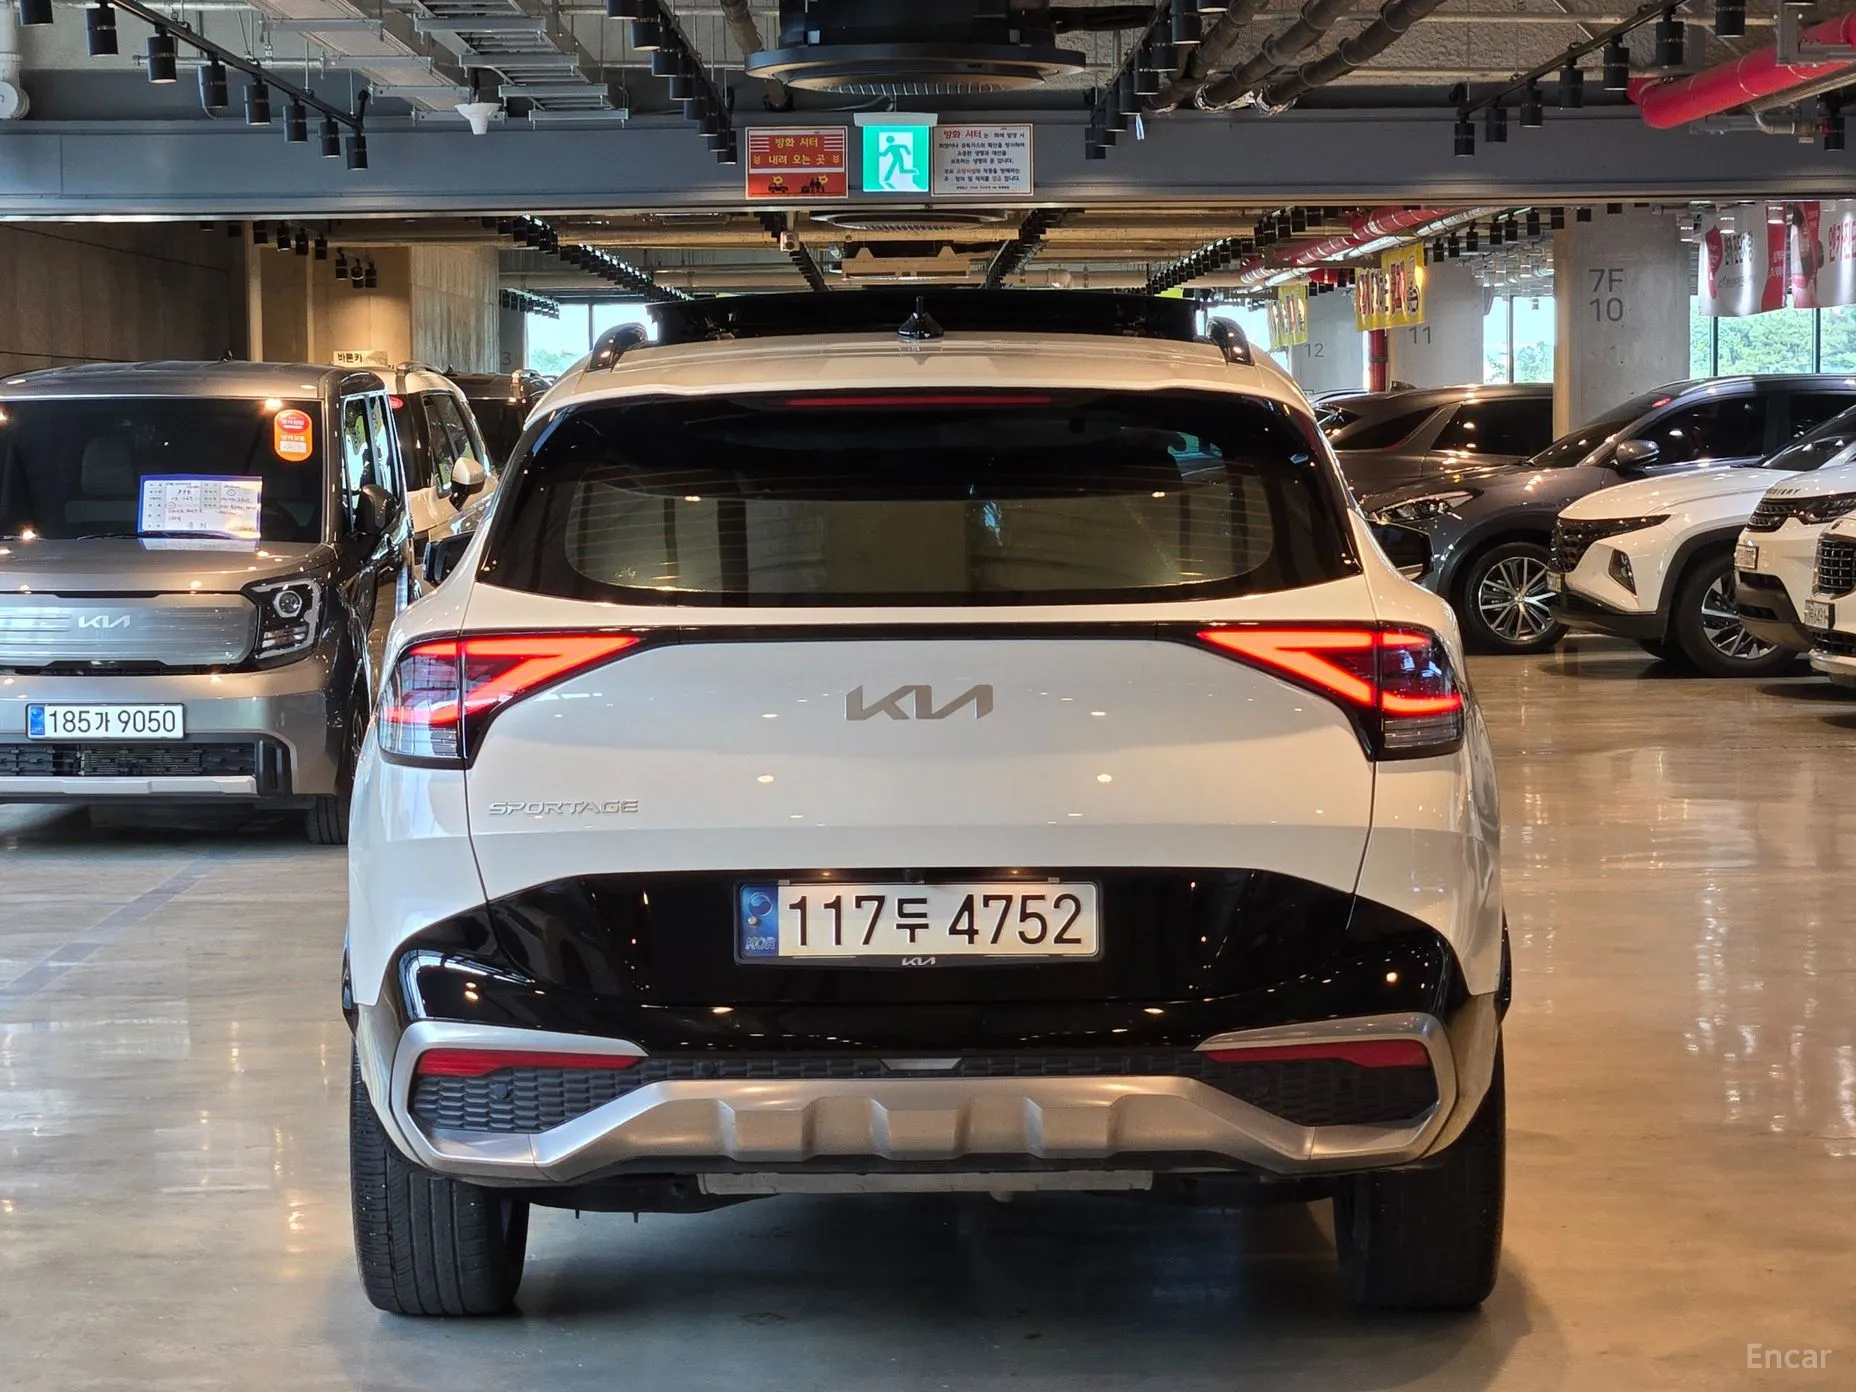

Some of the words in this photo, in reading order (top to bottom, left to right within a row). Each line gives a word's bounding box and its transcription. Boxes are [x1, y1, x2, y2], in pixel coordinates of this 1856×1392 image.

[775, 136, 795, 149] 방화
[768, 154, 788, 165] 내려
[792, 154, 811, 165] 오는
[816, 154, 826, 165] 곳
[1588, 268, 1624, 293] 7F
[1589, 297, 1624, 322] 10
[1408, 325, 1432, 345] 11
[1304, 343, 1325, 358] 12
[78, 614, 131, 628] KIA
[844, 683, 994, 722] KIA
[49, 709, 111, 733] 185가
[117, 709, 176, 733] 9050
[488, 799, 639, 816] SPORTAGE
[788, 894, 930, 947] 117두
[947, 893, 1083, 946] 4752
[902, 956, 936, 967] KIA
